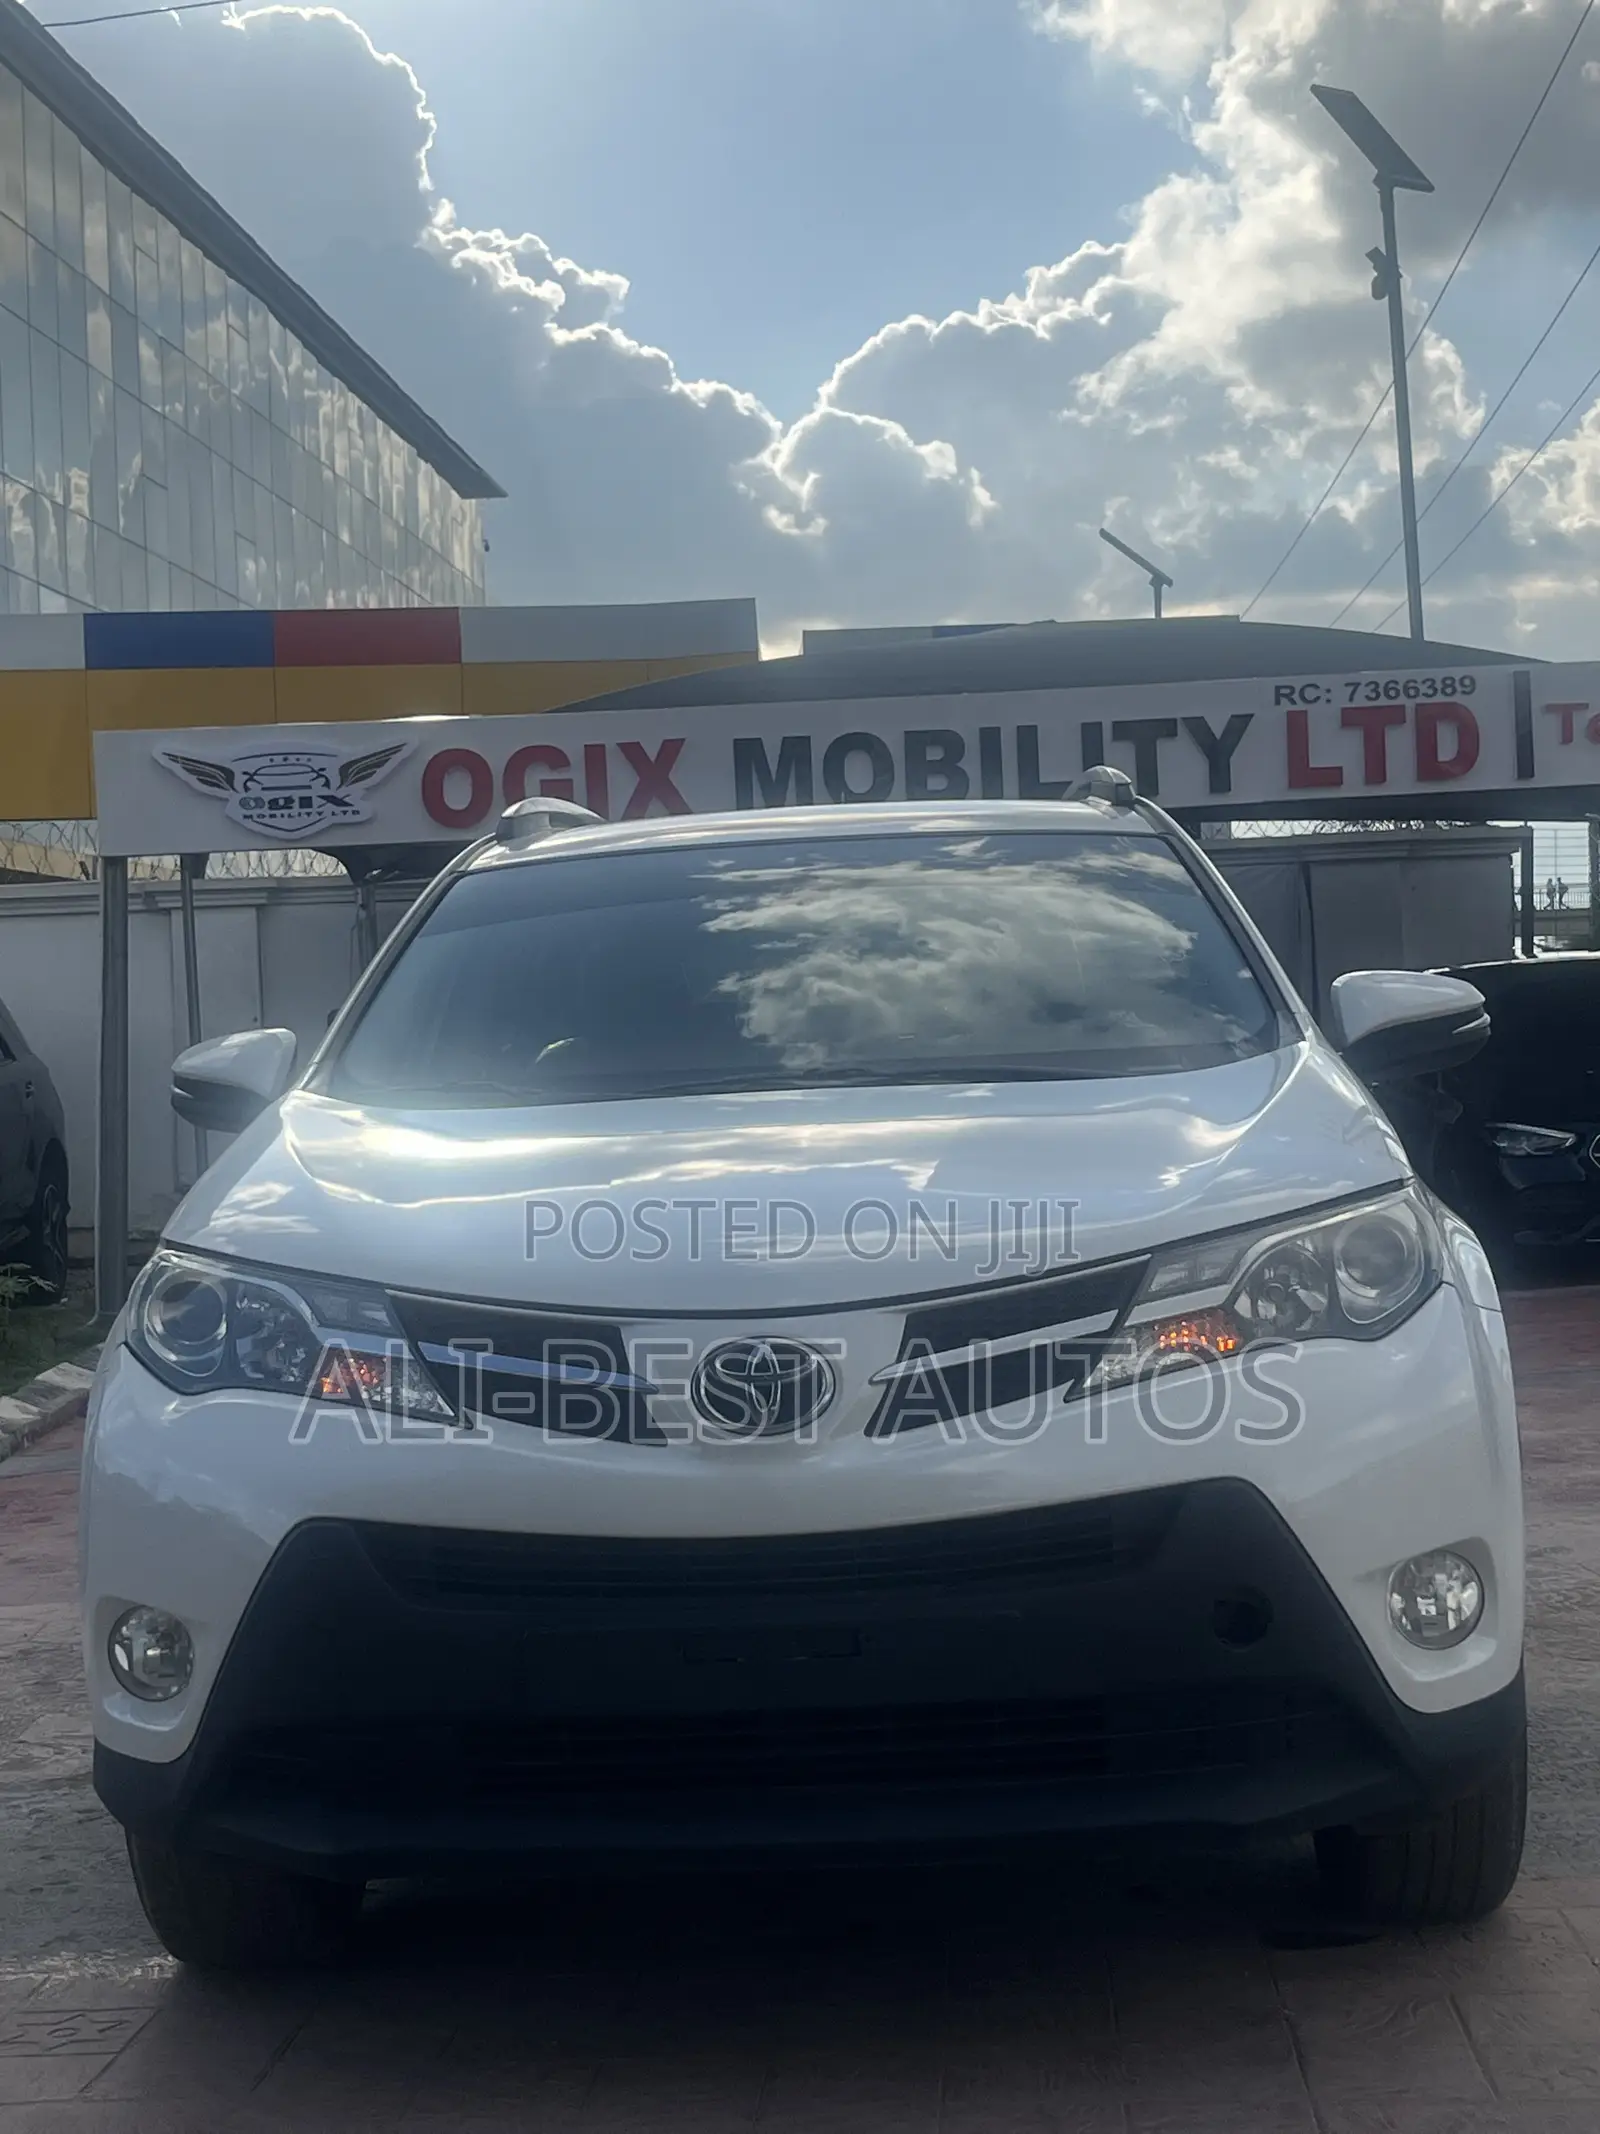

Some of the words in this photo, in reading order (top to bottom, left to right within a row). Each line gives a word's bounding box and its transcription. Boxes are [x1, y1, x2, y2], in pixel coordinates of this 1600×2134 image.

[1274, 683, 1332, 706] RC:
[1344, 675, 1476, 702] 7366389
[421, 738, 694, 829] OGIX
[733, 713, 1255, 811] MOBILITY
[1286, 702, 1481, 789] LTD
[243, 811, 325, 820] MOBILITY
[331, 809, 361, 817] LTD
